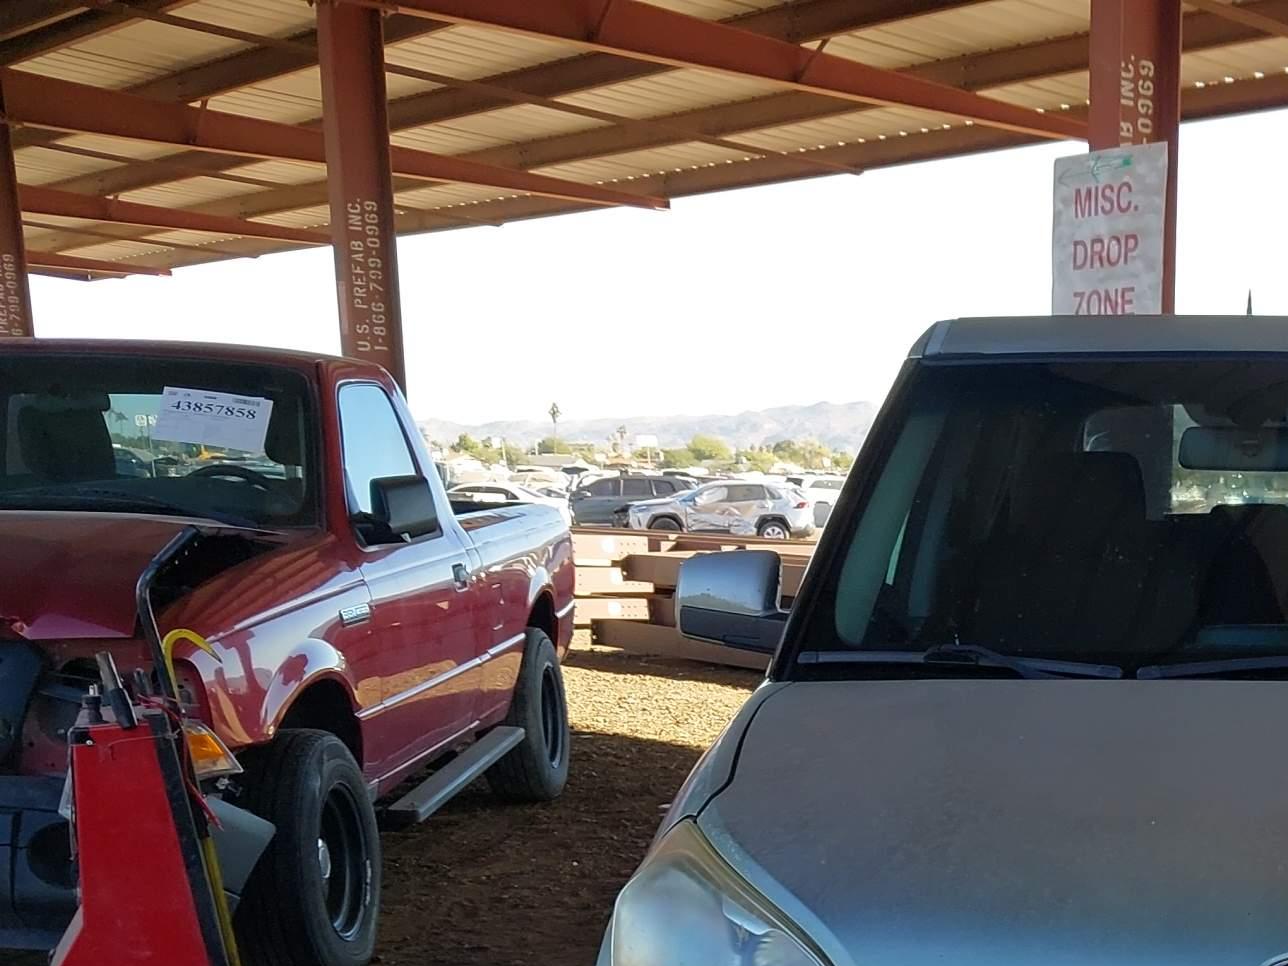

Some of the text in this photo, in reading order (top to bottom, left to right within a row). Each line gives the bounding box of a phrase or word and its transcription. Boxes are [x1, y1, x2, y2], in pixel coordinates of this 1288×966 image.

[1120, 53, 1136, 107] INC.
[1074, 181, 1139, 219] MISC.
[1072, 233, 1139, 271] DROP
[347, 198, 371, 352] U.S. PREFAB INC.
[1072, 286, 1136, 315] ZONE
[170, 400, 257, 420] 43857858
